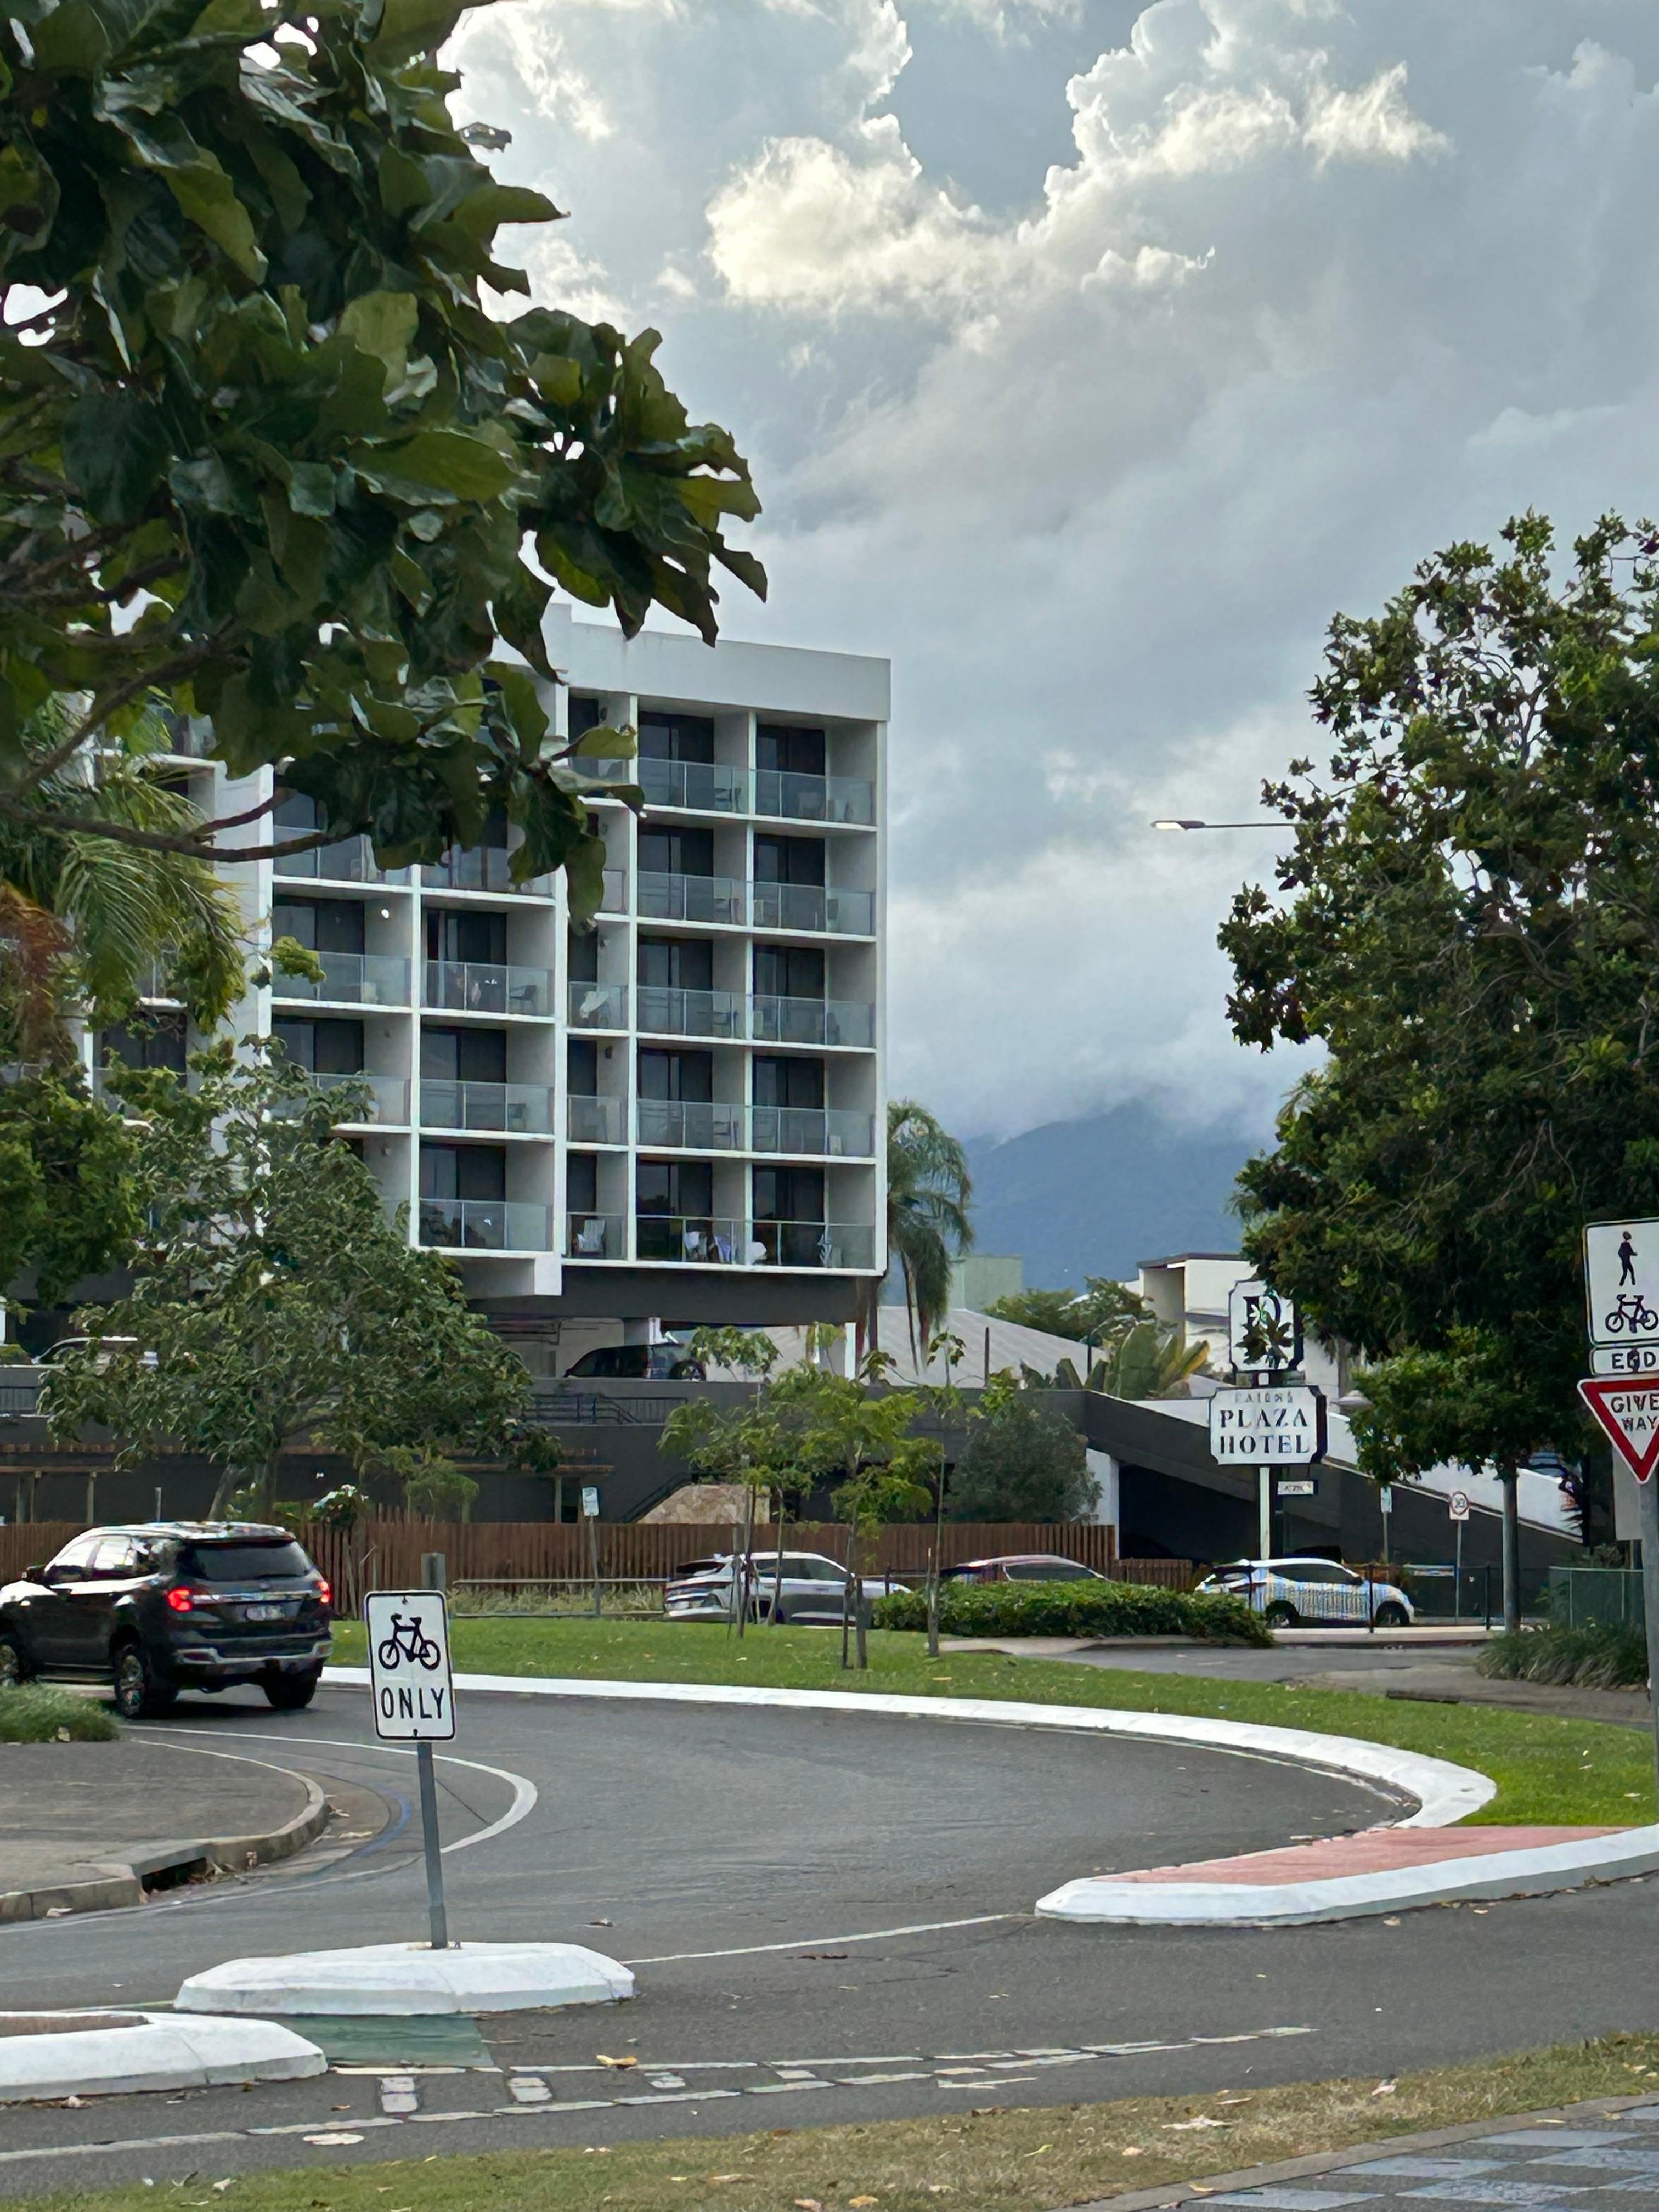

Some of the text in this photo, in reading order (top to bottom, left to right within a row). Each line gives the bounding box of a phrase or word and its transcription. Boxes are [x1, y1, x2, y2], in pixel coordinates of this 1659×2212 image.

[1610, 1393, 1659, 1414] GIVE
[1220, 1408, 1308, 1429] PLAZA
[1621, 1415, 1658, 1432] WAY
[1220, 1434, 1310, 1454] HOTEL
[380, 1687, 444, 1719] ONLY
